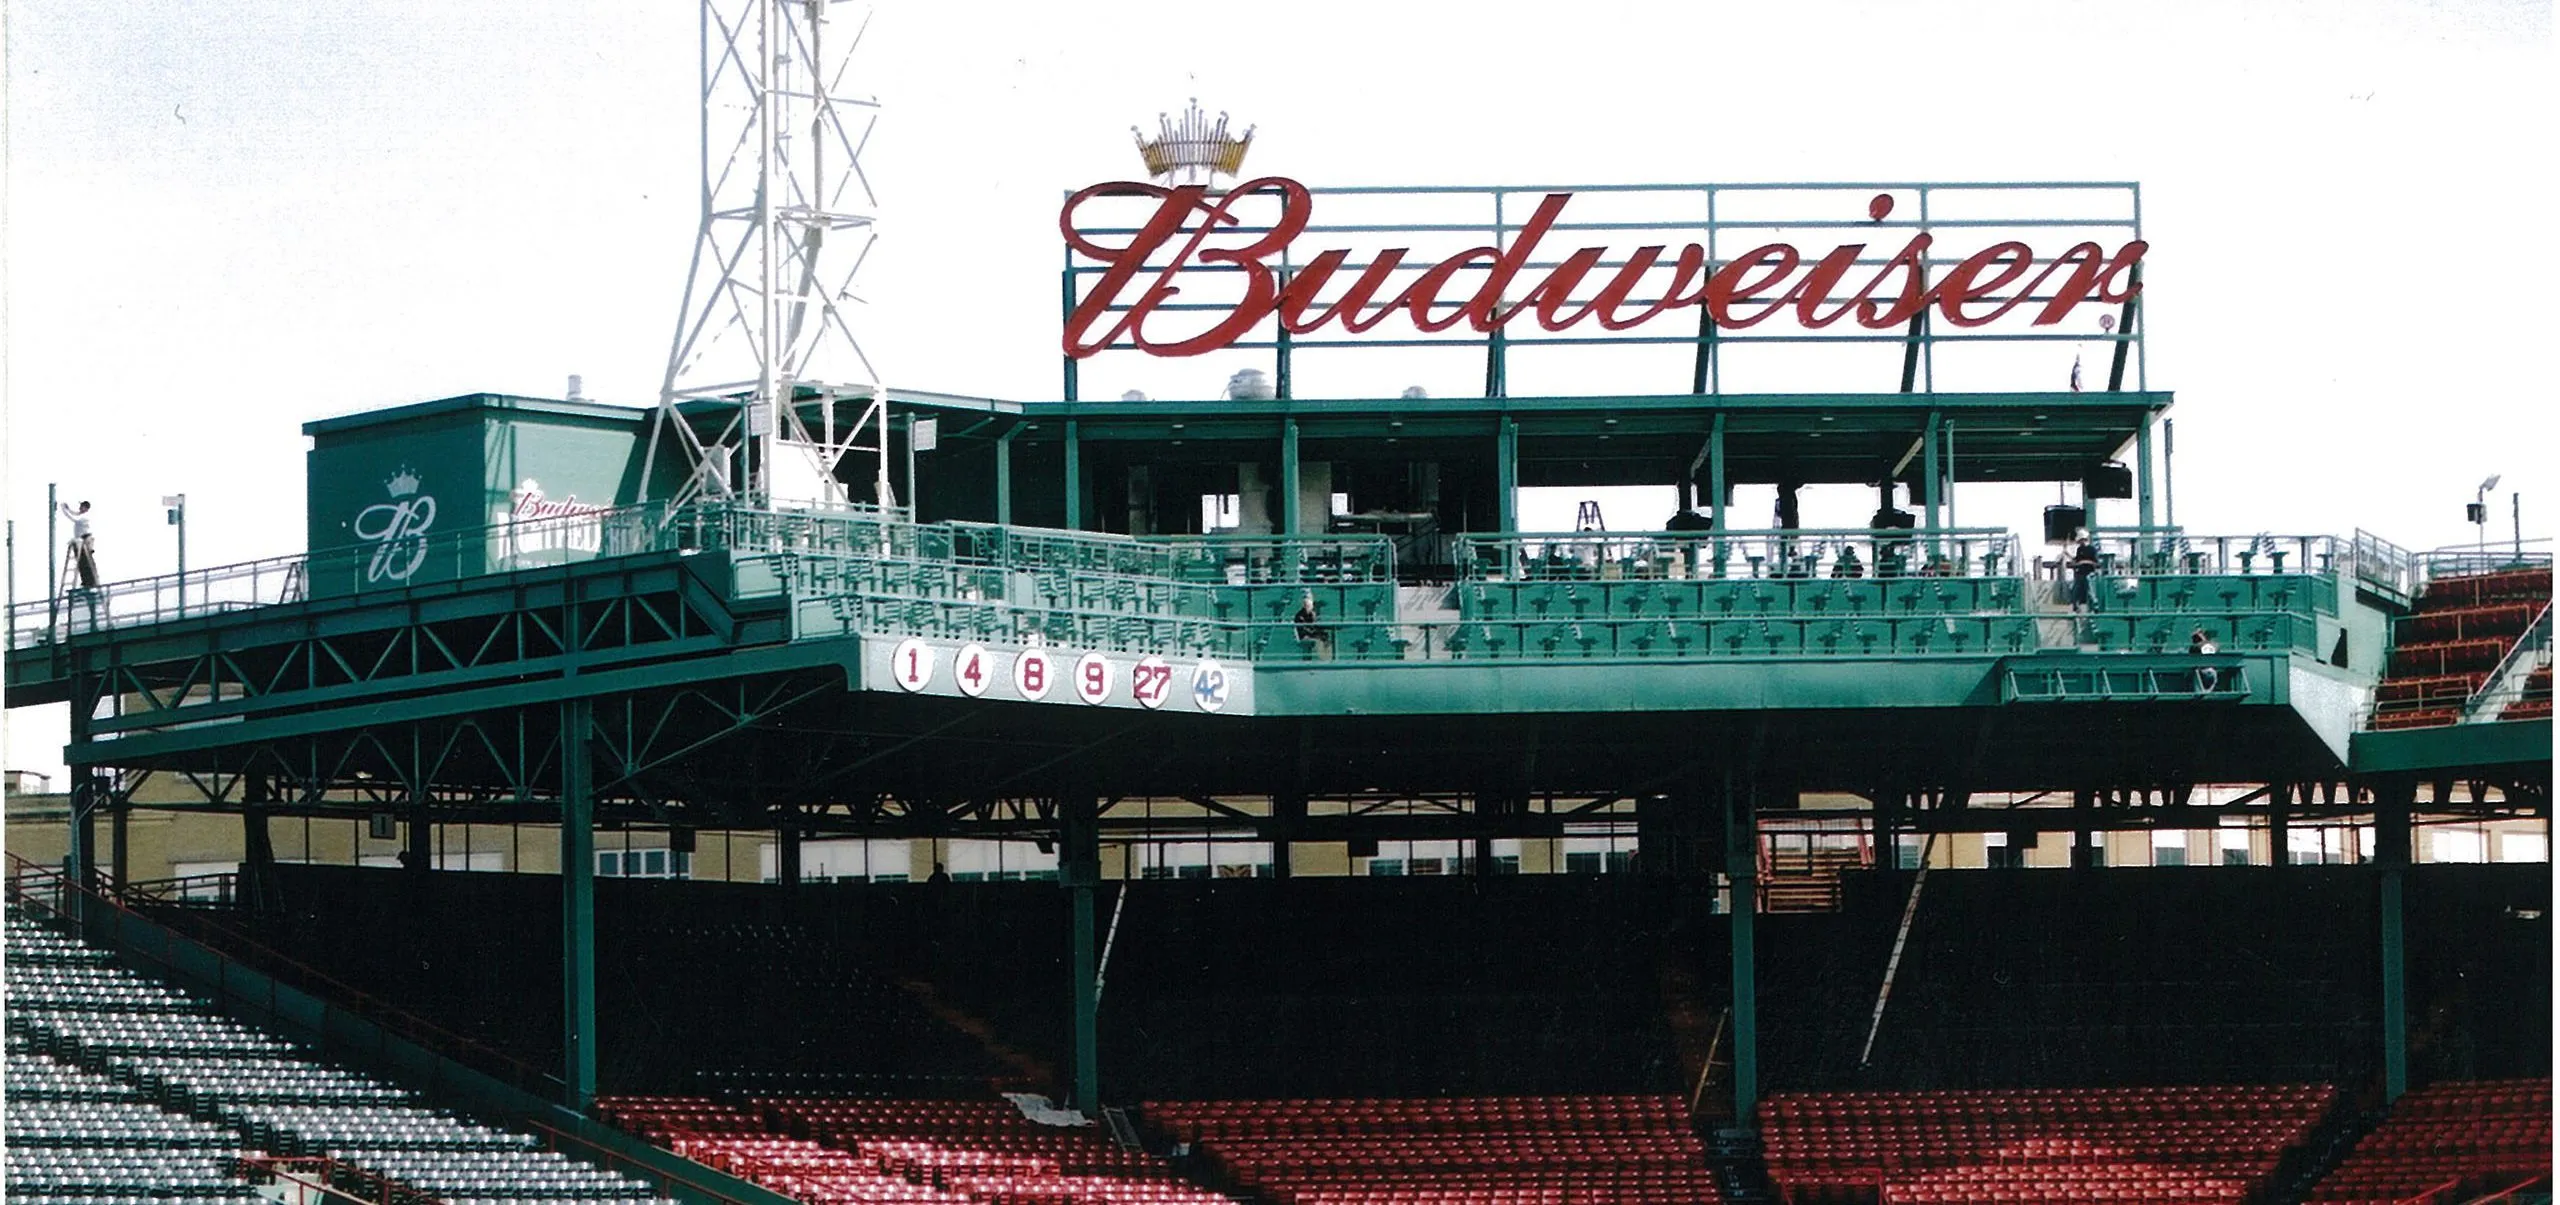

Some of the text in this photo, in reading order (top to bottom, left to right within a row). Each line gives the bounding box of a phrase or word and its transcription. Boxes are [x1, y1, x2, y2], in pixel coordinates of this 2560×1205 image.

[1060, 176, 2146, 358] Budweiser
[354, 495, 437, 583] B
[908, 648, 1224, 703] 1 4 8 9 27 42
